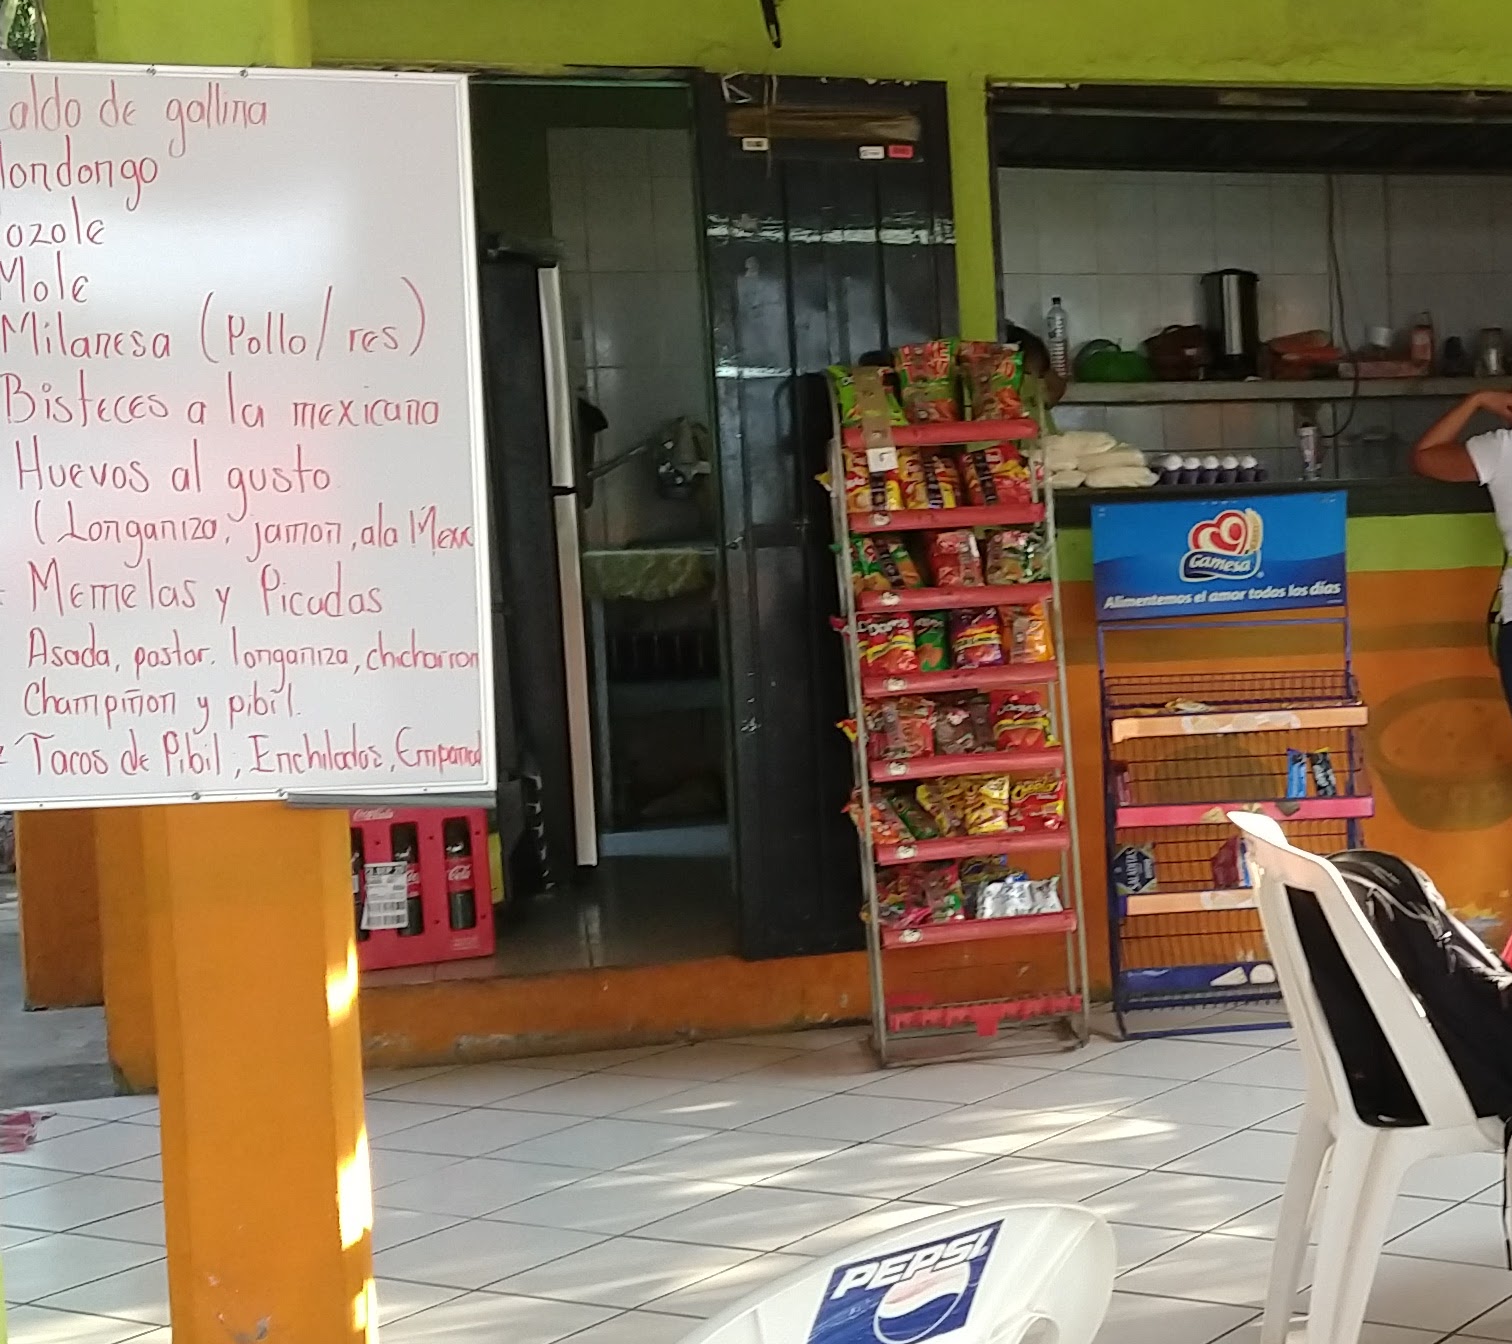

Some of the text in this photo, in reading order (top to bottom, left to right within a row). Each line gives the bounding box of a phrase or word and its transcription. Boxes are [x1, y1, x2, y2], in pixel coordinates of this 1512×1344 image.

[0, 74, 81, 131] aldo
[99, 79, 137, 127] de
[6, 196, 105, 248] ozole
[2, 311, 171, 358] Milanesa
[0, 369, 169, 427] Bisteces
[187, 400, 206, 425] a
[227, 371, 265, 428] la
[15, 434, 331, 522] Huevos al gusto
[1188, 552, 1251, 574] Gamesa
[28, 558, 383, 625] Memelas y Picadas
[1103, 593, 1193, 611] Alimentemos
[1193, 589, 1207, 604] el
[1208, 589, 1247, 602] amor
[1248, 585, 1285, 599] todos
[1287, 582, 1309, 597] los
[193, 695, 210, 735] y
[14, 731, 109, 776] Tacos
[121, 728, 150, 776] de
[829, 1226, 995, 1301] PEPSI
